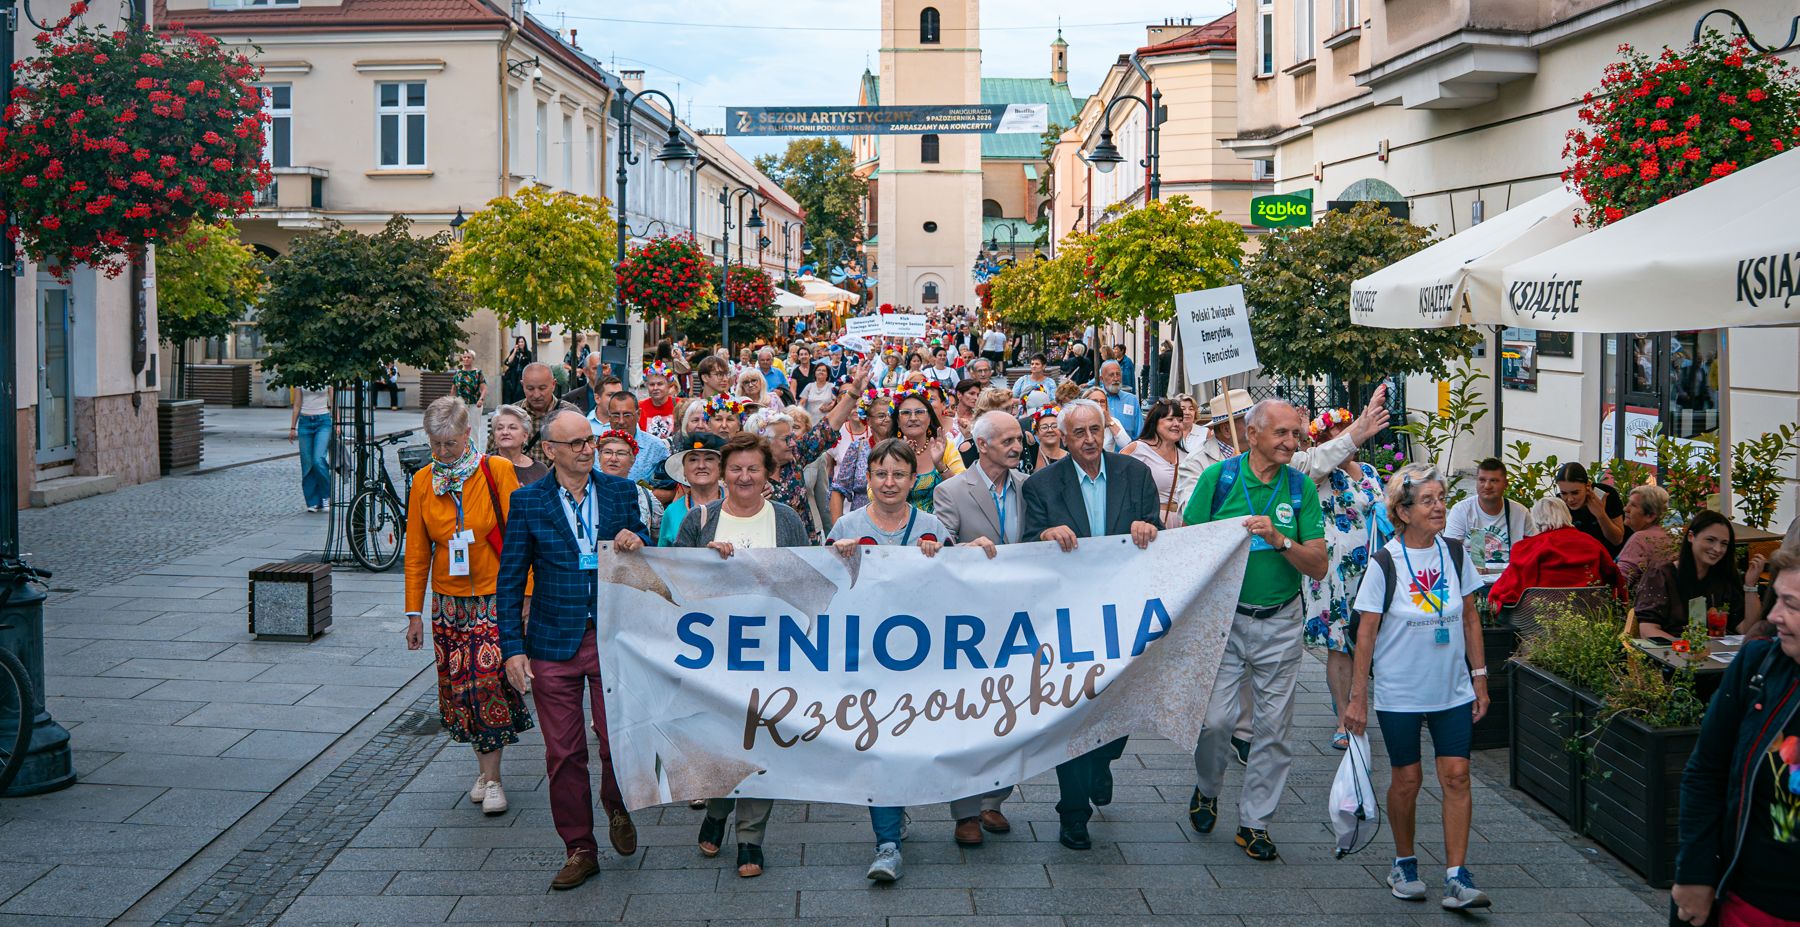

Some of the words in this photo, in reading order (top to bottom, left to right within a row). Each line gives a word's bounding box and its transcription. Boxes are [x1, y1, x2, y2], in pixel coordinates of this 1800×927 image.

[758, 112, 807, 124] SEZON
[810, 111, 913, 124] ARTYSTYCZNY
[931, 114, 975, 122] PAŹDZIERNIKA
[890, 123, 937, 131] ZAPRASZAMY
[950, 122, 992, 130] KONCERTY!
[1257, 201, 1307, 216] żabka
[1191, 307, 1211, 323] Polski
[1210, 304, 1236, 320] Związek
[1201, 325, 1234, 342] Emerytów,
[1203, 352, 1207, 365] i
[1207, 344, 1240, 364] Rencistów
[674, 597, 1172, 673] SENIORALIA
[743, 643, 1110, 751] Rzeszowskie
